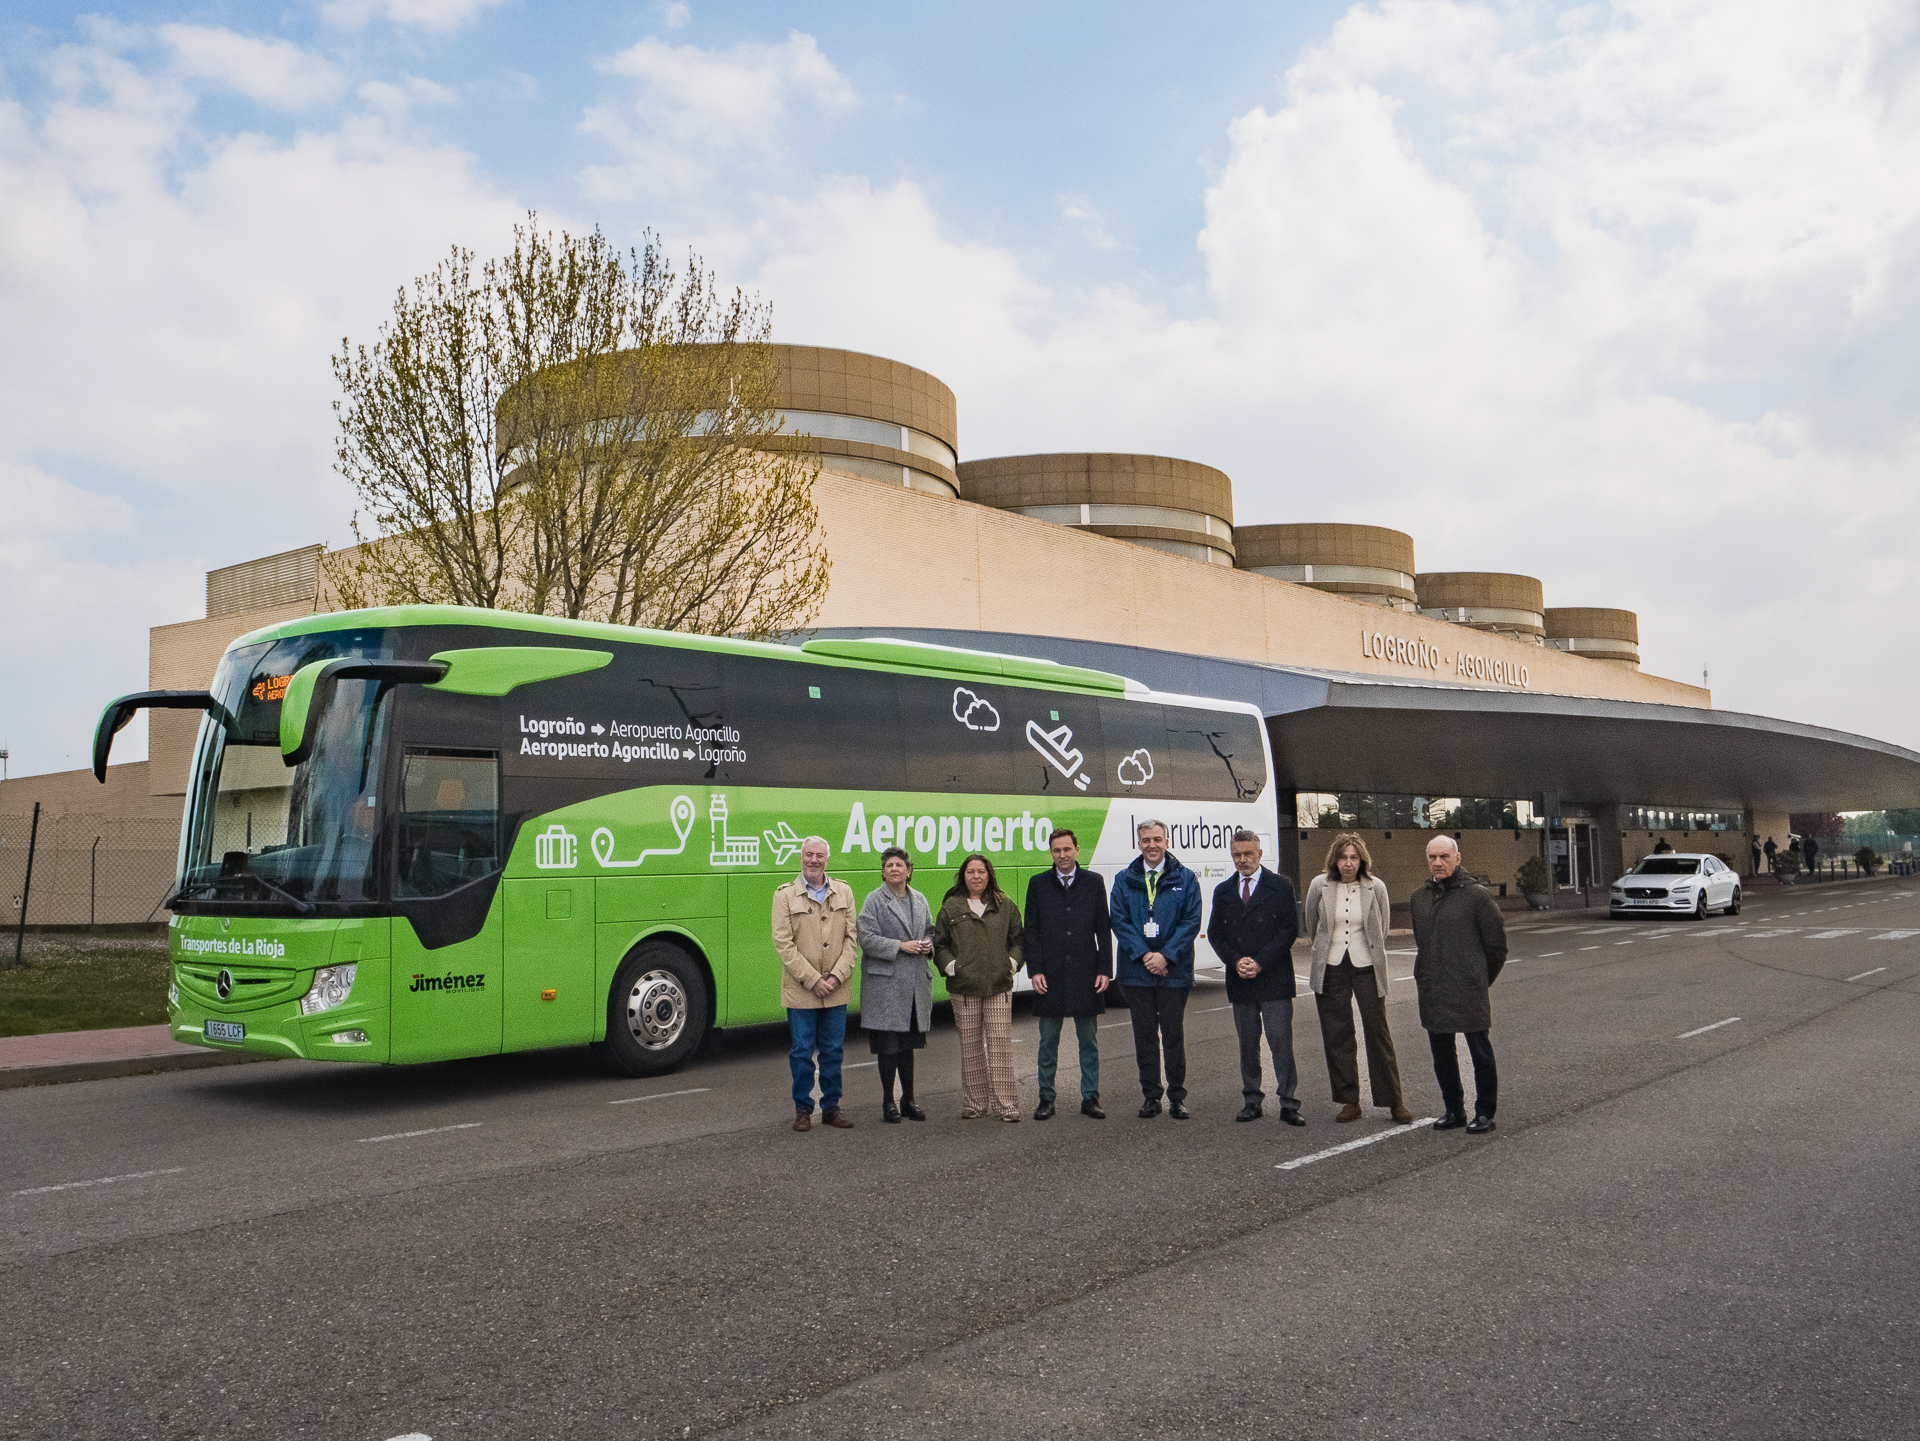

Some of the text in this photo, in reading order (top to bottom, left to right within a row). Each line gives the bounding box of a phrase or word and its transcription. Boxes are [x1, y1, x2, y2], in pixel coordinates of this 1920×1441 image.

[1362, 630, 1440, 670] LOGROÑO
[1456, 651, 1529, 688] AGONCILLO
[520, 715, 740, 744] Logroño Aeropuerto Agoncillo
[520, 738, 747, 765] Aeropuerto Agoncillo Logroño
[841, 802, 1053, 865] Aeropuerto
[180, 935, 285, 959] Transportes de La Rioja
[410, 972, 485, 992] Jiménez
[445, 986, 485, 994] MOVILIDAD
[209, 1022, 242, 1038] 1655 LCF
